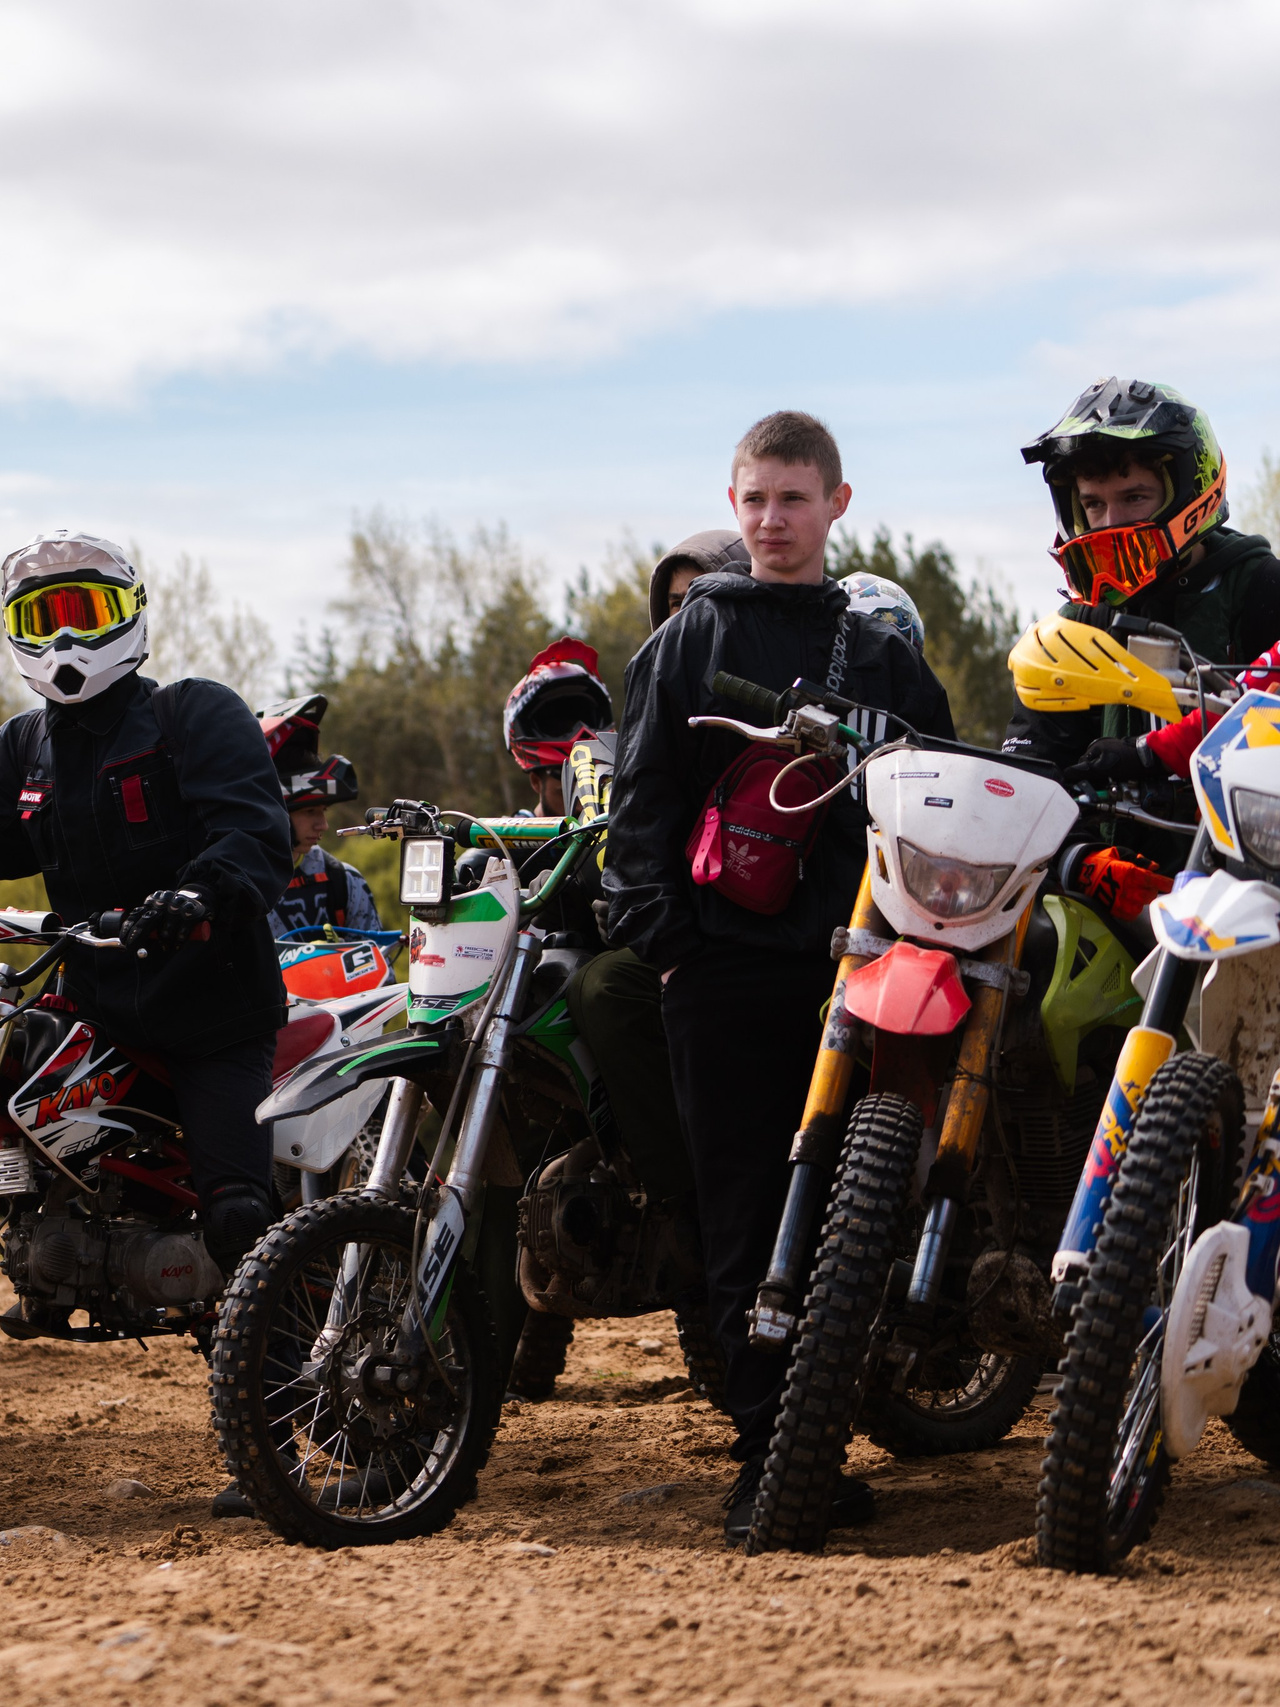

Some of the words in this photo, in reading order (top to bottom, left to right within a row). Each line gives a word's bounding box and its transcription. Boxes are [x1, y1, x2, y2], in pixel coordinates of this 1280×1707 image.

[1183, 476, 1224, 535] GTX
[729, 825, 762, 839] adidas
[34, 1071, 117, 1129] KAYO
[160, 1264, 193, 1278] KAYO
